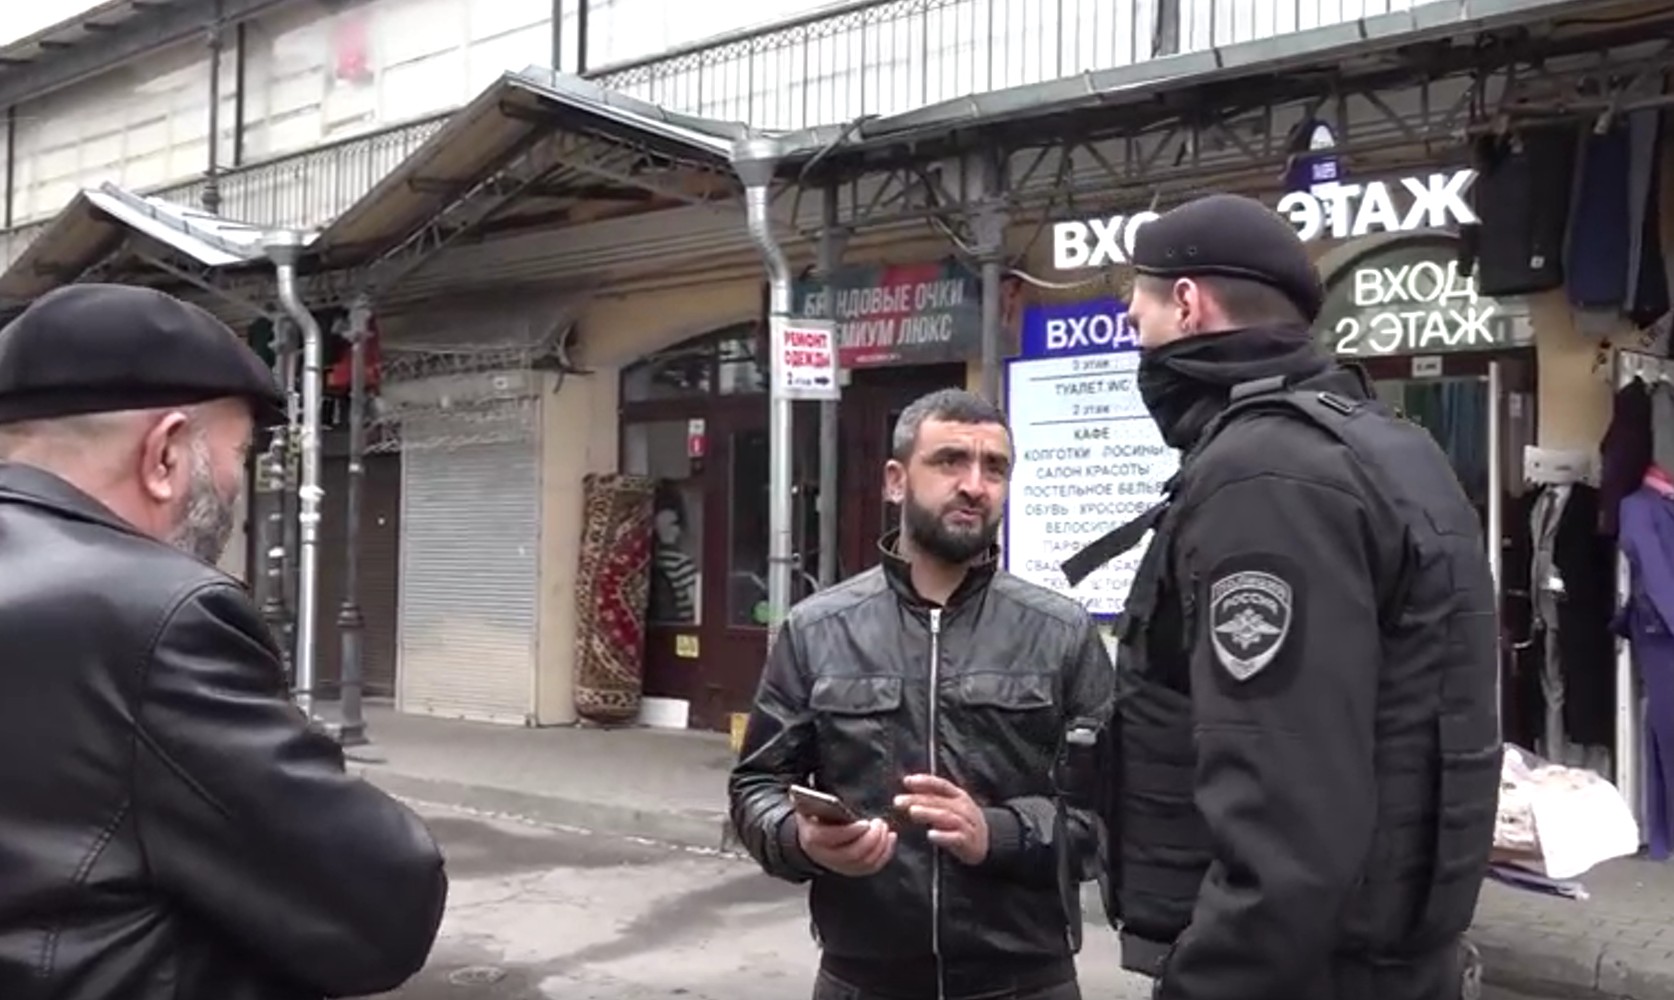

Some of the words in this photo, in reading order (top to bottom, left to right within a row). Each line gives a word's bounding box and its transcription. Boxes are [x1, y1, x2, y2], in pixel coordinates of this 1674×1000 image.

[1276, 169, 1480, 241] ЭТАЖ
[1355, 260, 1478, 306] ВХОД
[803, 284, 911, 319] БРНДОВЫЕ
[914, 278, 964, 312] ОЧКИ
[896, 314, 953, 345] ЛЮКС
[1046, 312, 1139, 349] ВХОД
[1335, 317, 1360, 353] 2
[1369, 306, 1495, 352] ЭТАЖ
[784, 331, 828, 348] РЕМОНТ
[784, 350, 831, 368] ОДЕЖДЫ
[1055, 380, 1103, 396] ТУАЛЕТ
[1108, 378, 1130, 392] WC
[1072, 404, 1080, 416] 2
[1073, 426, 1111, 441] КАФЕ
[1036, 466, 1083, 479] САЛОН
[1085, 464, 1150, 478] КРАСОТЫ
[1023, 483, 1114, 498] ПОСТЕЛЬНОЕ
[1025, 503, 1069, 516] ОБУВЬ
